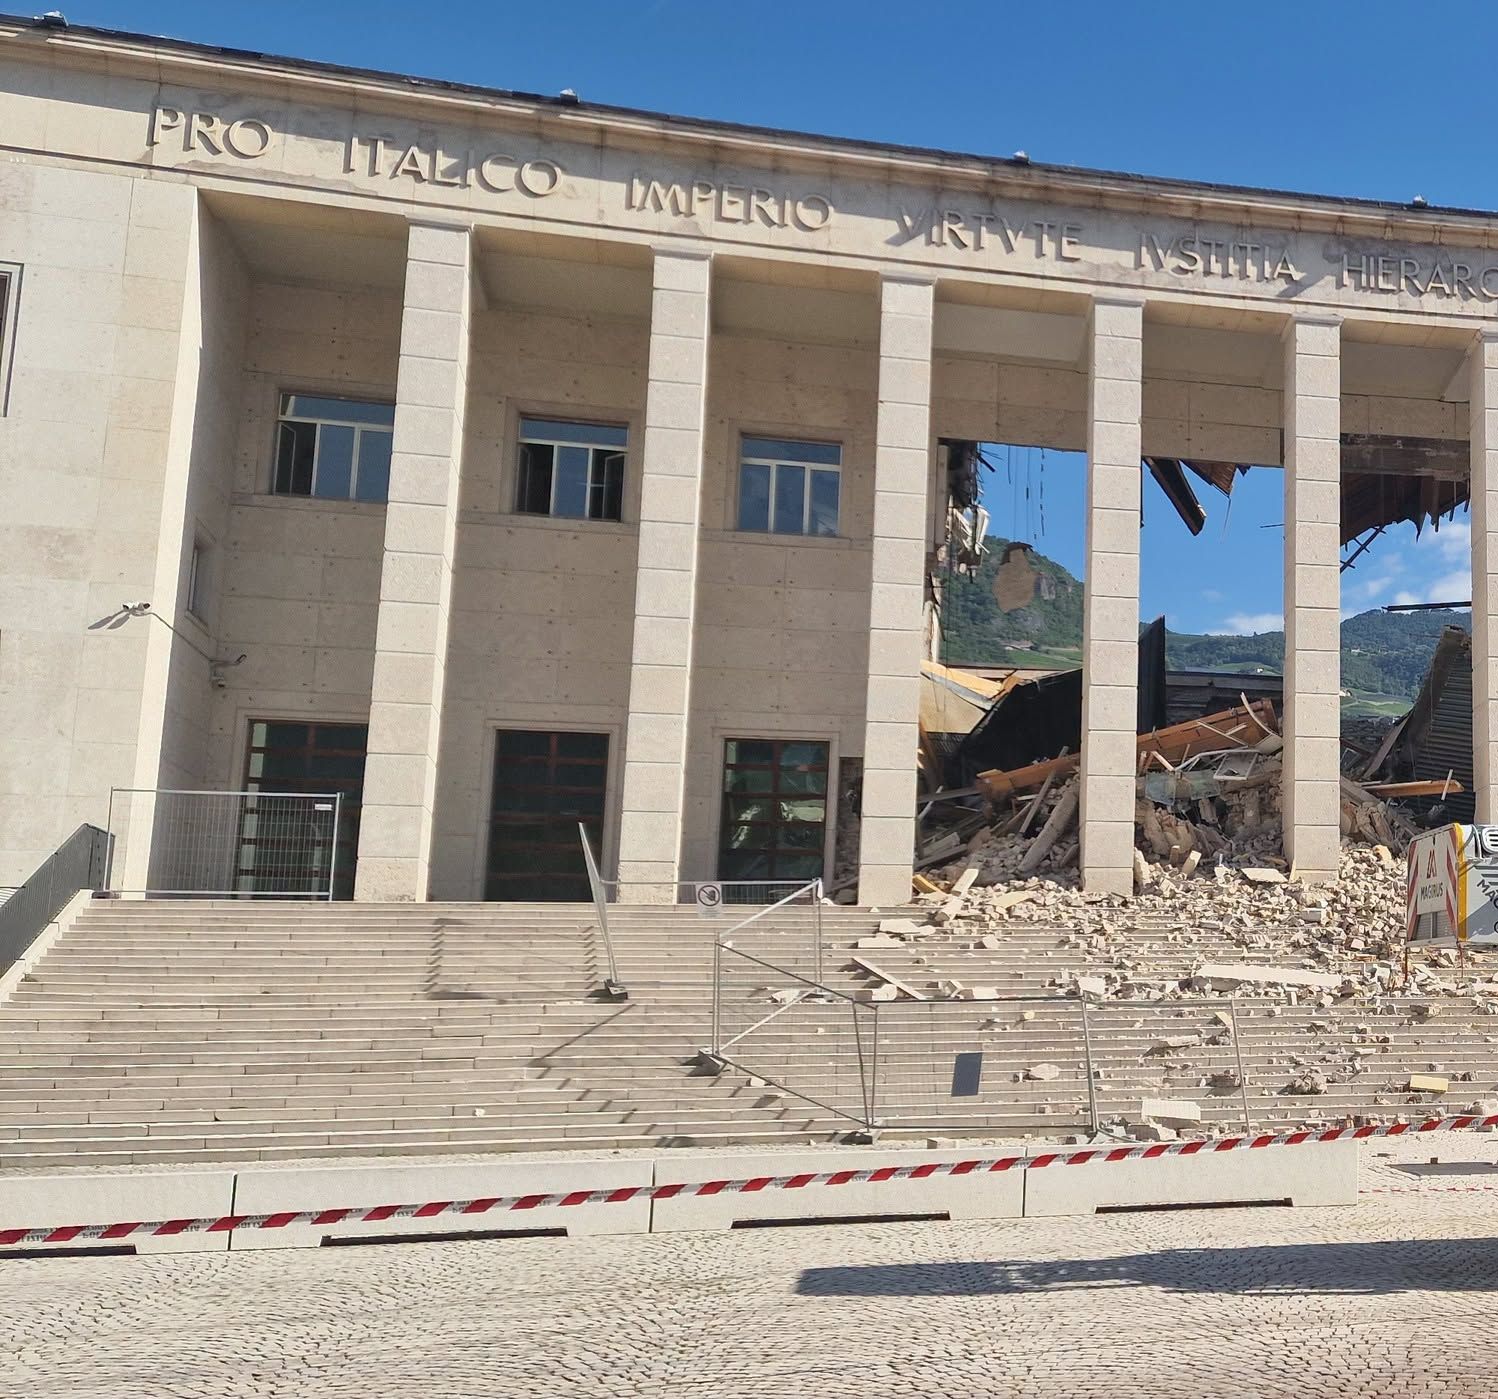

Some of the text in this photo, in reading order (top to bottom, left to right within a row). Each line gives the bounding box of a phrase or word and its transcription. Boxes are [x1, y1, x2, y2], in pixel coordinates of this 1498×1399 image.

[152, 107, 273, 158] PRO
[347, 135, 563, 197] ITALICO
[627, 172, 835, 231] IMPERIO
[896, 205, 1082, 262] VIRTVTE
[1137, 232, 1301, 282] IVSTITIA
